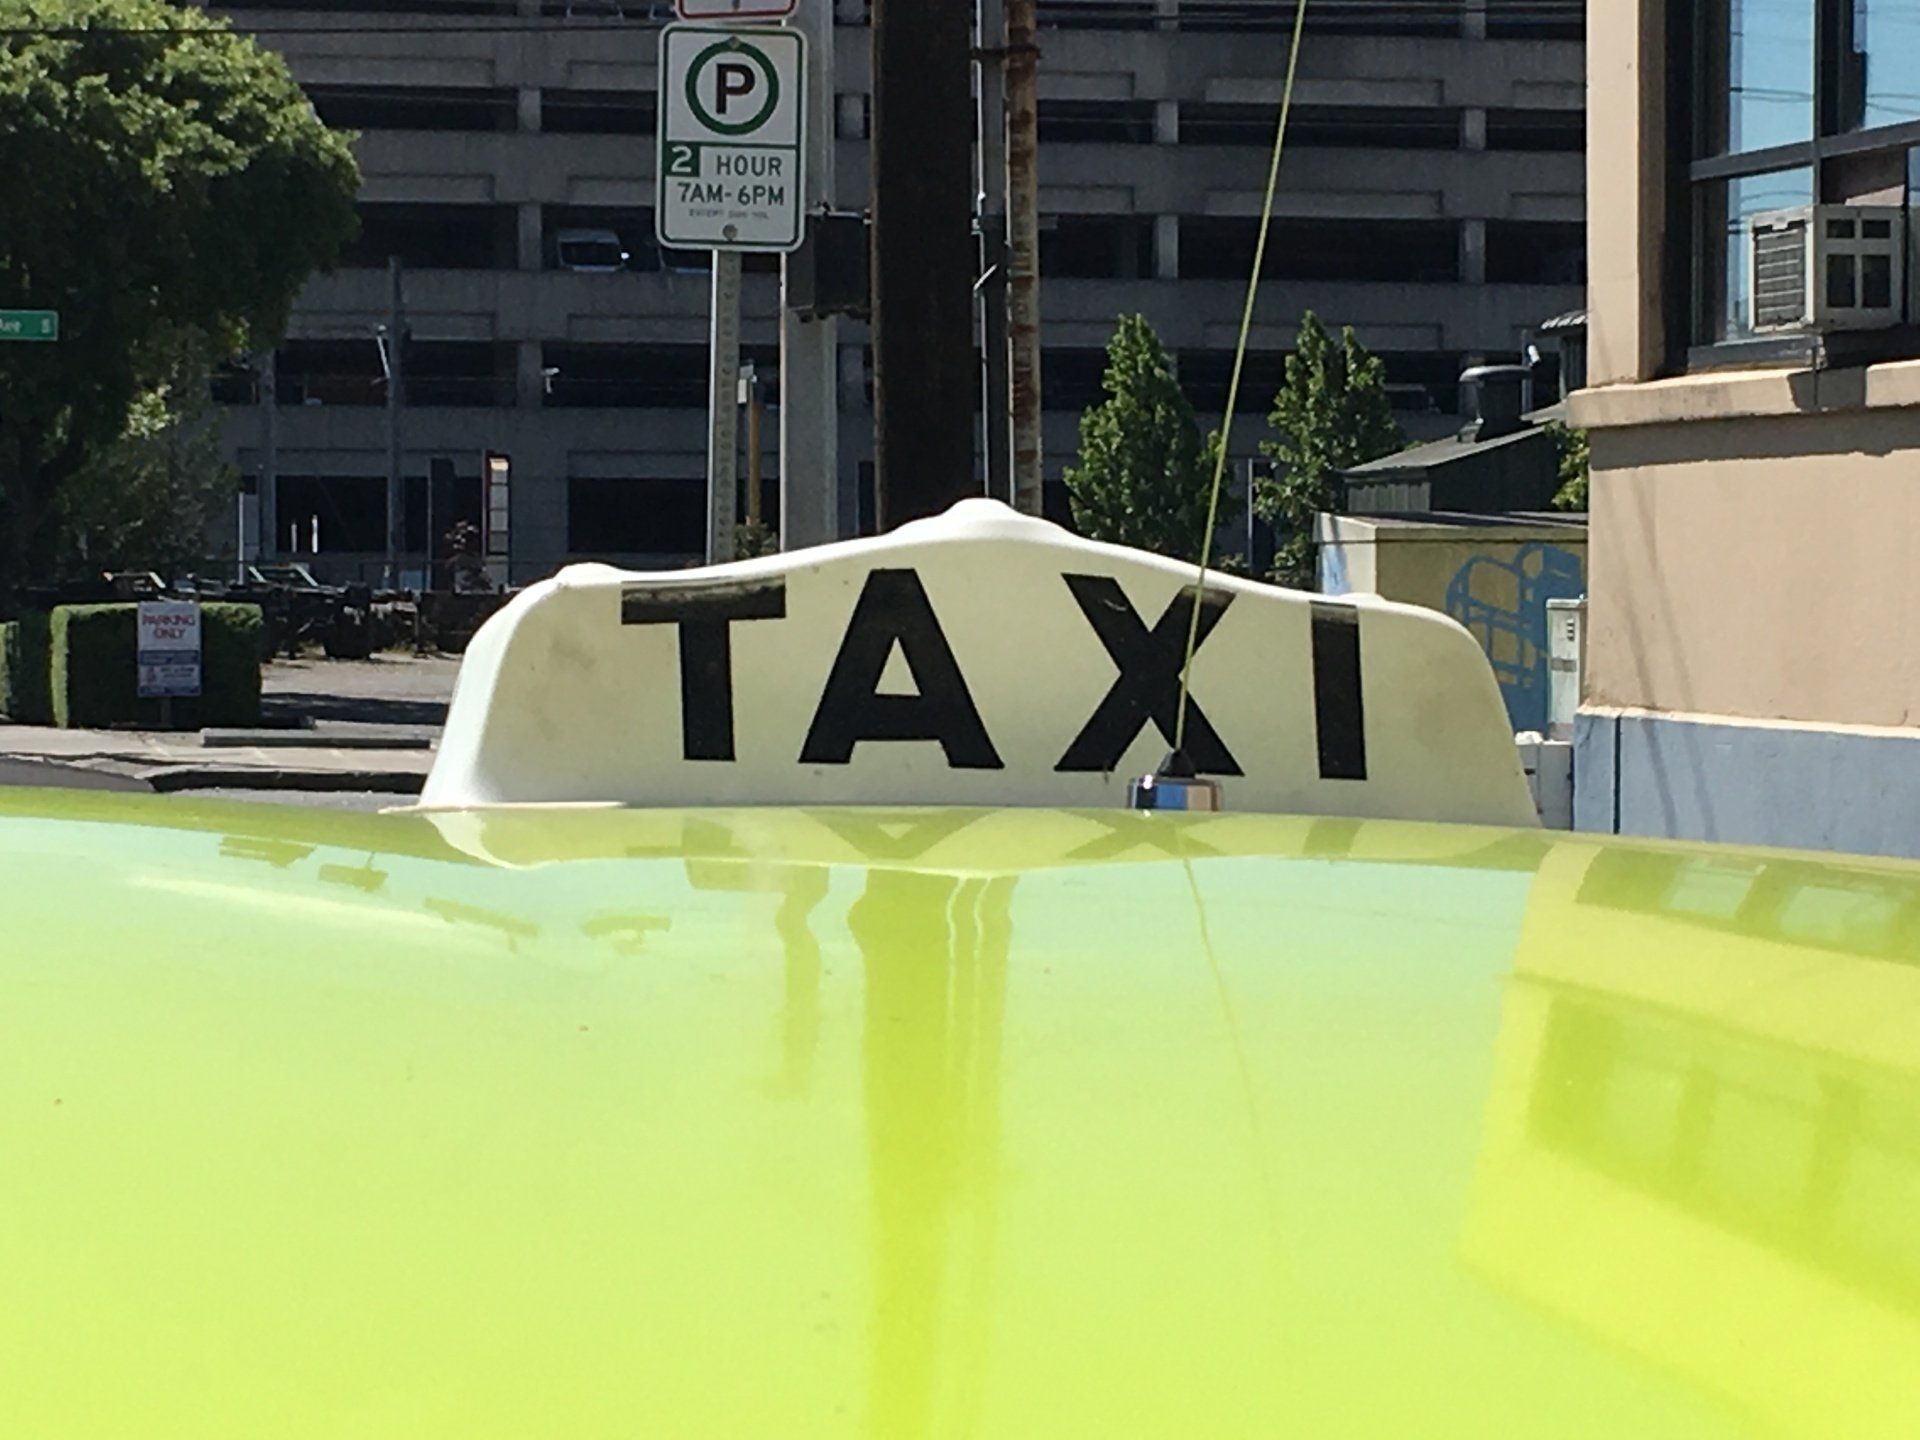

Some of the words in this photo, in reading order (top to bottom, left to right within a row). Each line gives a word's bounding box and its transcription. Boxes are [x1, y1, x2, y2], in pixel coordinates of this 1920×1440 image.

[715, 63, 756, 115] P
[670, 145, 692, 173] 2
[716, 154, 782, 177] HOUR
[142, 614, 196, 626] PARKING
[153, 628, 187, 639] ONLY
[621, 568, 1366, 780] TAXI
